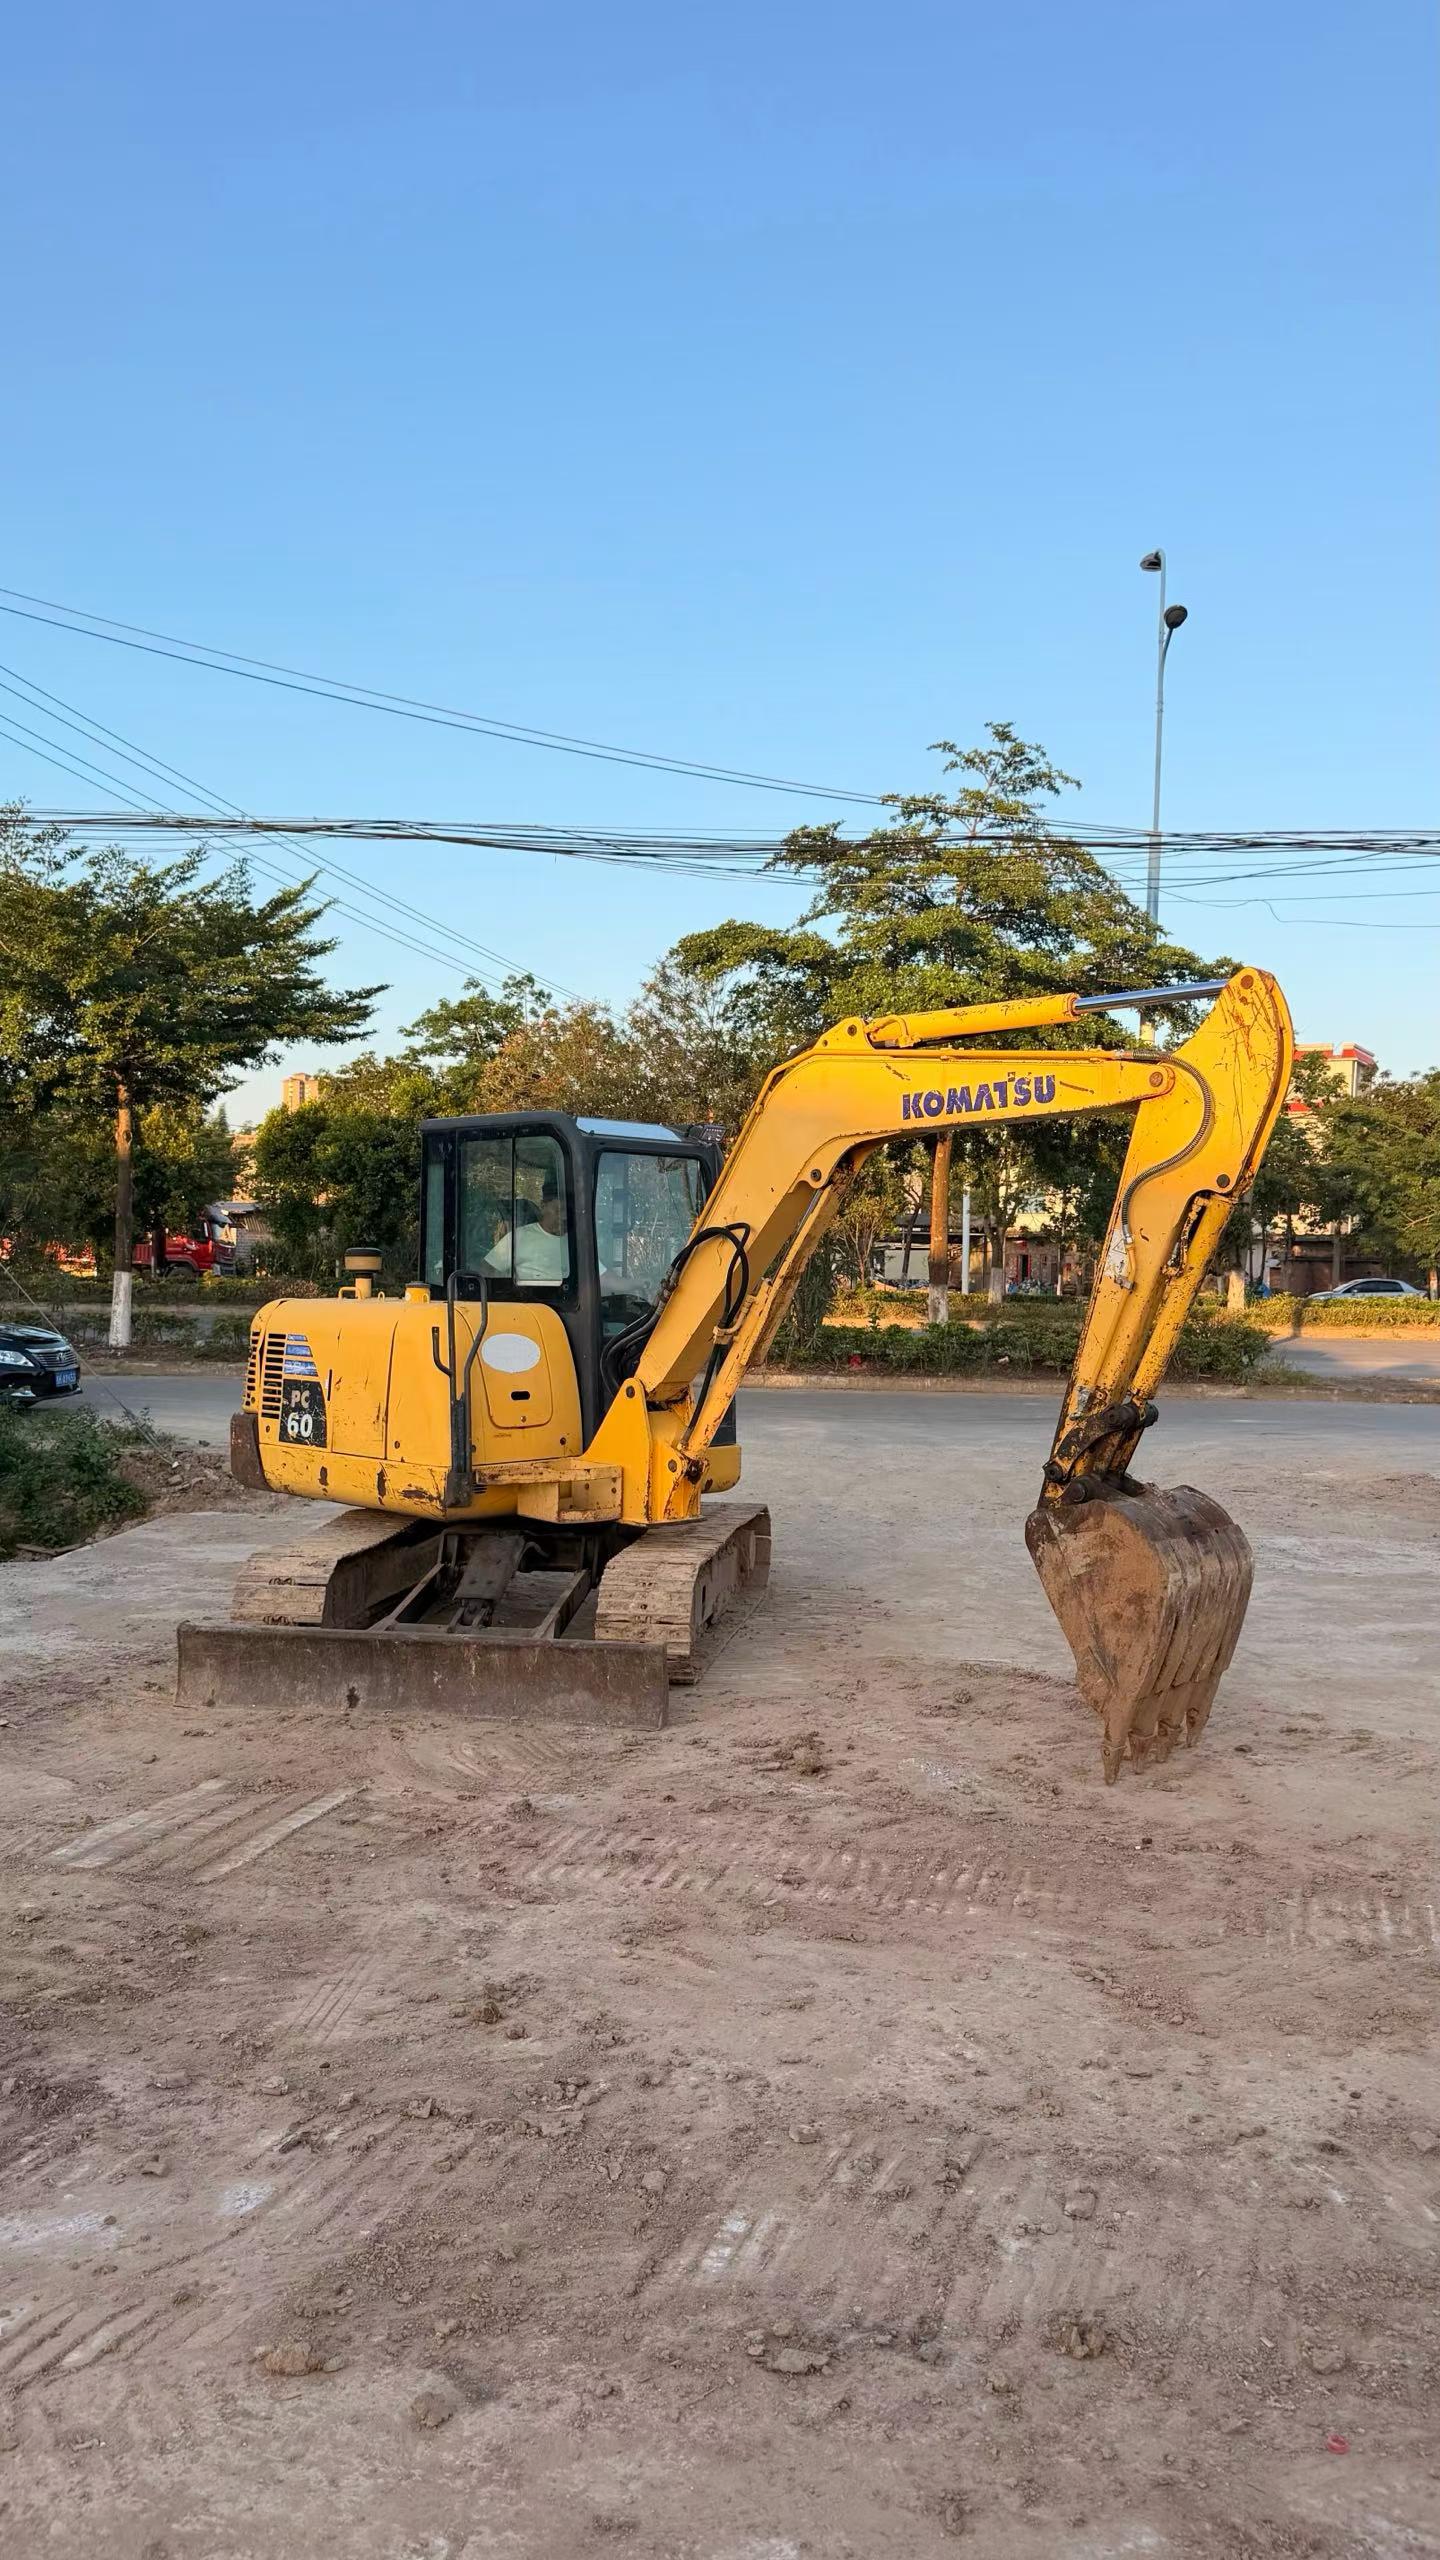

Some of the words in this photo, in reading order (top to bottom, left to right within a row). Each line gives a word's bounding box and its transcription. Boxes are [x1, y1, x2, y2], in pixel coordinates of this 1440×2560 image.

[902, 1073, 1056, 1120] KOMATSU
[290, 1389, 311, 1409] PC
[287, 1411, 313, 1439] 60
